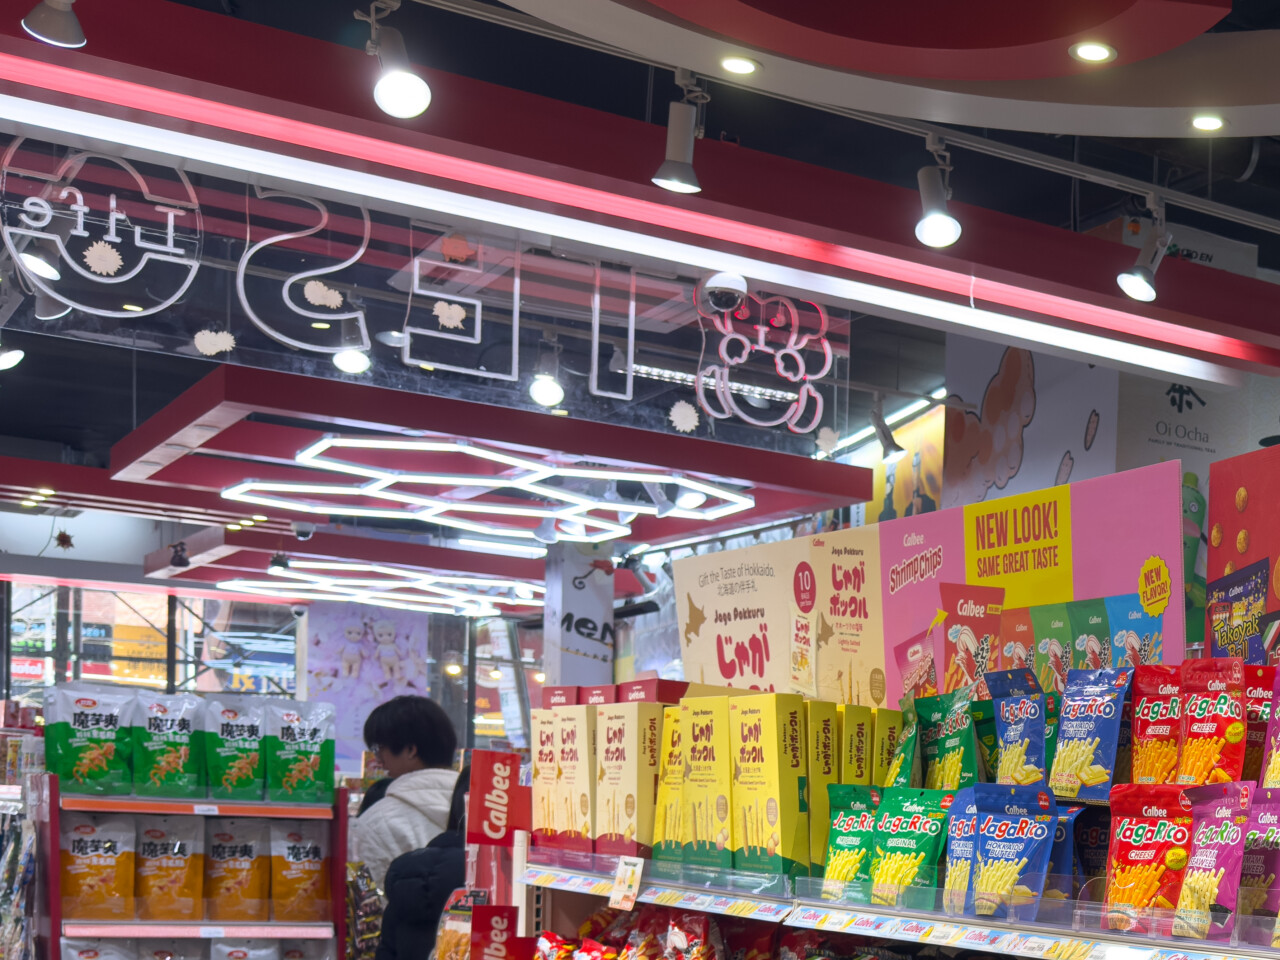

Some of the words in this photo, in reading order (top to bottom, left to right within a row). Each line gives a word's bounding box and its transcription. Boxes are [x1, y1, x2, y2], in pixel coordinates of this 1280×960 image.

[1155, 420, 1172, 437] Oi
[1174, 423, 1210, 443] Ocha
[976, 510, 1008, 551] NEW
[1014, 501, 1058, 545] LOOK!
[977, 556, 1000, 578] SAME
[1003, 551, 1029, 575] GREAT
[1031, 546, 1059, 570] TASTE
[699, 574, 708, 588] Gift
[709, 571, 720, 583] the
[720, 567, 736, 580] Taste
[737, 564, 744, 577] of
[798, 570, 811, 591] 10
[1144, 565, 1161, 587] NEW
[714, 609, 732, 626] Jaga
[733, 607, 765, 622] Pokkuru
[957, 599, 985, 618] Calbee
[716, 623, 770, 680] じゃが
[1062, 721, 1094, 731] HOKKAIDO
[1146, 725, 1170, 735] CHEESE
[1191, 723, 1217, 733] CHEESE
[690, 745, 715, 762] ポックル
[1005, 804, 1028, 815] Calbee
[1143, 806, 1167, 817] Calbee
[980, 816, 1048, 840] JagaRico
[986, 840, 1024, 850] HOKKAIDO
[989, 849, 1016, 858] BUTTER
